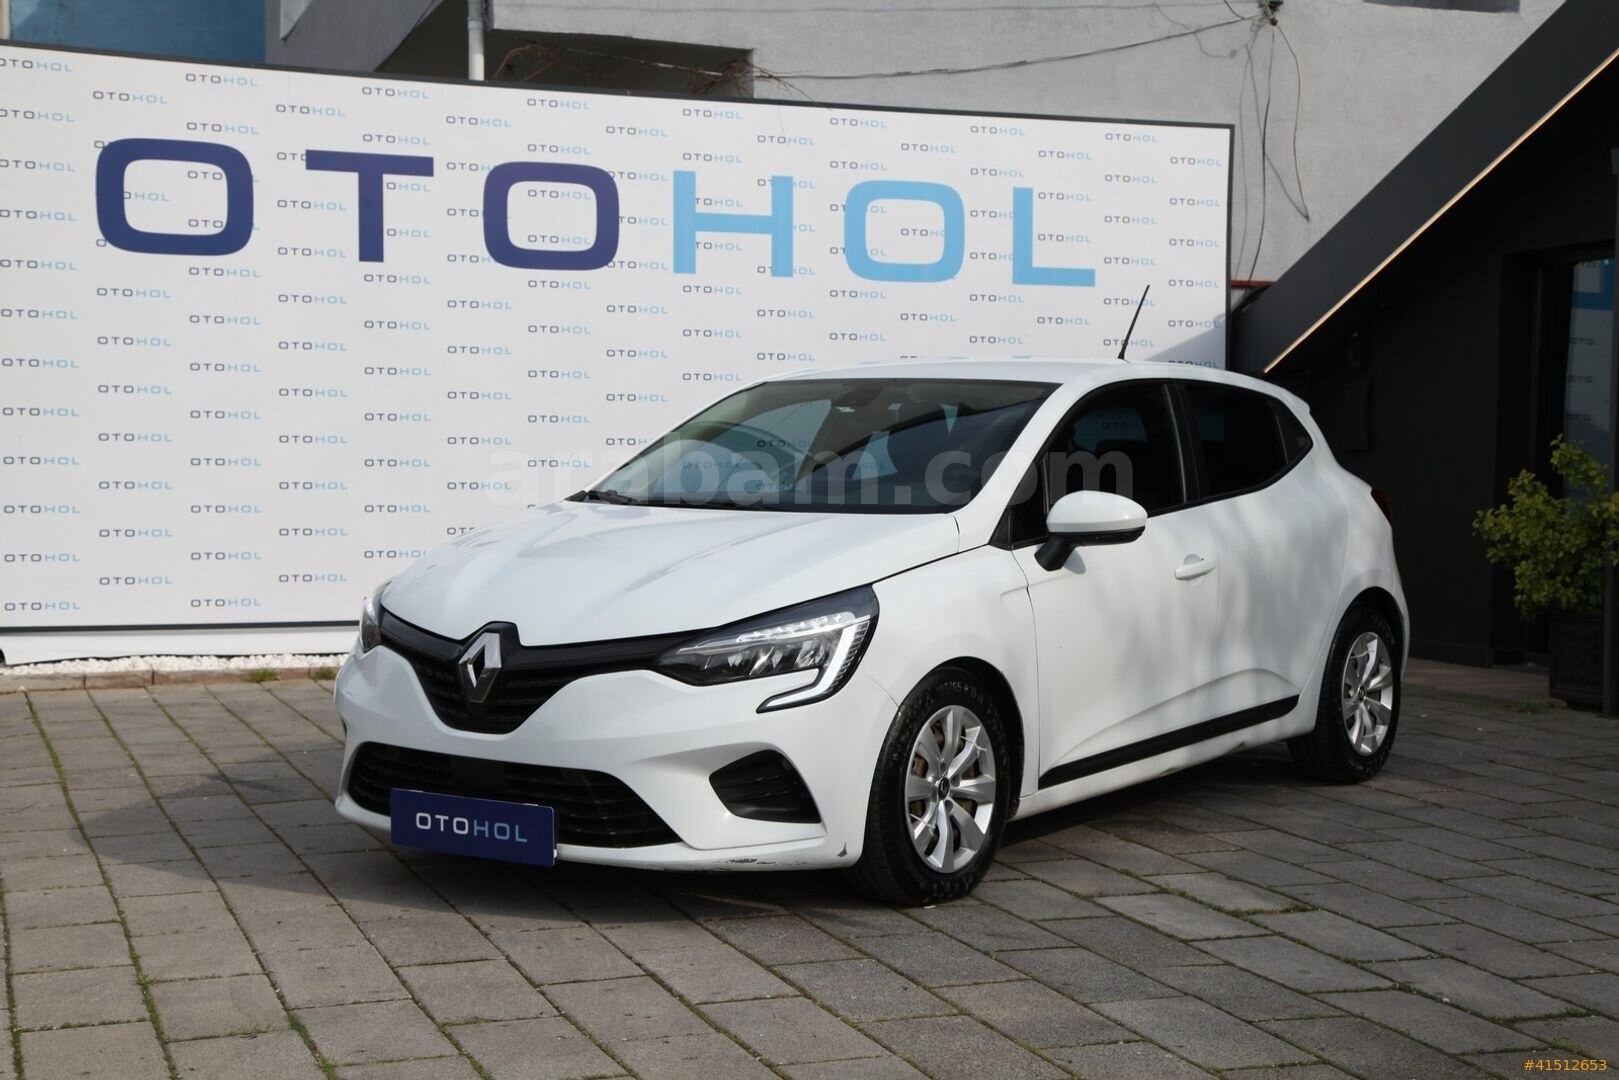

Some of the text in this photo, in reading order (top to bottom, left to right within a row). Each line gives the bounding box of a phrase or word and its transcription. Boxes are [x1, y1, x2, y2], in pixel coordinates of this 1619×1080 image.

[185, 73, 257, 87] OTOHOL
[92, 90, 167, 104] OTOHOL
[362, 86, 430, 99] OTOHOL
[526, 98, 589, 110] OTOHOL
[0, 108, 74, 122] OTOHOL
[275, 104, 345, 117] OTOHOL
[682, 108, 742, 119] OTOHOL
[446, 116, 511, 128] OTOHOL
[829, 117, 886, 128] OTOHOL
[186, 122, 258, 134] OTOHOL
[606, 126, 667, 137] OTOHOL
[970, 125, 1024, 136] OTOHOL
[362, 133, 429, 145] OTOHOL
[757, 135, 815, 145] OTOHOL
[1104, 133, 1158, 143] OTOHOL
[527, 144, 591, 155] OTOHOL
[901, 143, 956, 153] OTOHOL
[682, 152, 743, 164] OTOHOL
[1038, 150, 1092, 160] OTOHOL
[0, 159, 75, 172] OTOHOL
[830, 160, 887, 171] OTOHOL
[1170, 156, 1223, 166] OTOHOL
[970, 168, 1024, 178] OTOHOL
[1104, 174, 1157, 184] OTOHOL
[528, 189, 591, 200] OTOHOL
[1038, 192, 1092, 202] OTOHOL
[277, 200, 347, 211] OTOHOL
[1169, 198, 1221, 207] OTOHOL
[0, 209, 76, 221] OTOHOL
[95, 138, 1095, 288] OTOHOL
[1104, 216, 1156, 224] OTOHOL
[528, 234, 591, 245] OTOHOL
[1038, 233, 1092, 243] OTOHOL
[1169, 238, 1220, 248] OTOHOL
[277, 247, 347, 258] OTOHOL
[0, 258, 77, 270] OTOHOL
[1104, 257, 1156, 266] OTOHOL
[188, 267, 260, 278] OTOHOL
[363, 274, 430, 284] OTOHOL
[1168, 279, 1219, 288] OTOHOL
[528, 280, 591, 290] OTOHOL
[682, 285, 742, 295] OTOHOL
[96, 288, 171, 298] OTOHOL
[829, 290, 887, 299] OTOHOL
[278, 294, 347, 304] OTOHOL
[969, 294, 1024, 303] OTOHOL
[447, 299, 512, 309] OTOHOL
[606, 304, 668, 314] OTOHOL
[0, 308, 78, 320] OTOHOL
[757, 308, 815, 318] OTOHOL
[900, 312, 956, 322] OTOHOL
[189, 314, 261, 325] OTOHOL
[1037, 316, 1090, 325] OTOHOL
[1168, 320, 1219, 329] OTOHOL
[364, 320, 431, 330] OTOHOL
[528, 325, 591, 335] OTOHOL
[682, 328, 742, 338] OTOHOL
[829, 332, 886, 341] OTOHOL
[97, 336, 171, 347] OTOHOL
[969, 336, 1024, 344] OTOHOL
[278, 341, 347, 351] OTOHOL
[447, 345, 512, 355] OTOHOL
[606, 349, 667, 358] OTOHOL
[756, 352, 815, 361] OTOHOL
[1, 358, 79, 368] OTOHOL
[189, 362, 261, 373] OTOHOL
[364, 366, 432, 376] OTOHOL
[528, 369, 591, 379] OTOHOL
[682, 373, 742, 383] OTOHOL
[97, 385, 172, 395] OTOHOL
[278, 388, 348, 397] OTOHOL
[447, 391, 512, 400] OTOHOL
[606, 393, 668, 402] OTOHOL
[2, 407, 80, 417] OTOHOL
[190, 410, 261, 420] OTOHOL
[364, 412, 431, 422] OTOHOL
[528, 415, 590, 423] OTOHOL
[98, 433, 173, 442] OTOHOL
[278, 435, 348, 444] OTOHOL
[446, 436, 512, 445] OTOHOL
[2, 456, 80, 465] OTOHOL
[190, 457, 262, 467] OTOHOL
[364, 458, 432, 469] OTOHOL
[527, 459, 591, 469] OTOHOL
[98, 480, 172, 490] OTOHOL
[278, 481, 348, 490] OTOHOL
[447, 481, 512, 491] OTOHOL
[3, 504, 80, 514] OTOHOL
[190, 504, 261, 513] OTOHOL
[364, 504, 430, 513] OTOHOL
[99, 528, 173, 538] OTOHOL
[279, 528, 347, 536] OTOHOL
[4, 553, 80, 563] OTOHOL
[190, 552, 261, 560] OTOHOL
[99, 576, 172, 586] OTOHOL
[278, 573, 347, 583] OTOHOL
[4, 601, 80, 611] OTOHOL
[190, 598, 261, 608] OTOHOL
[416, 812, 528, 843] OTOHOL
